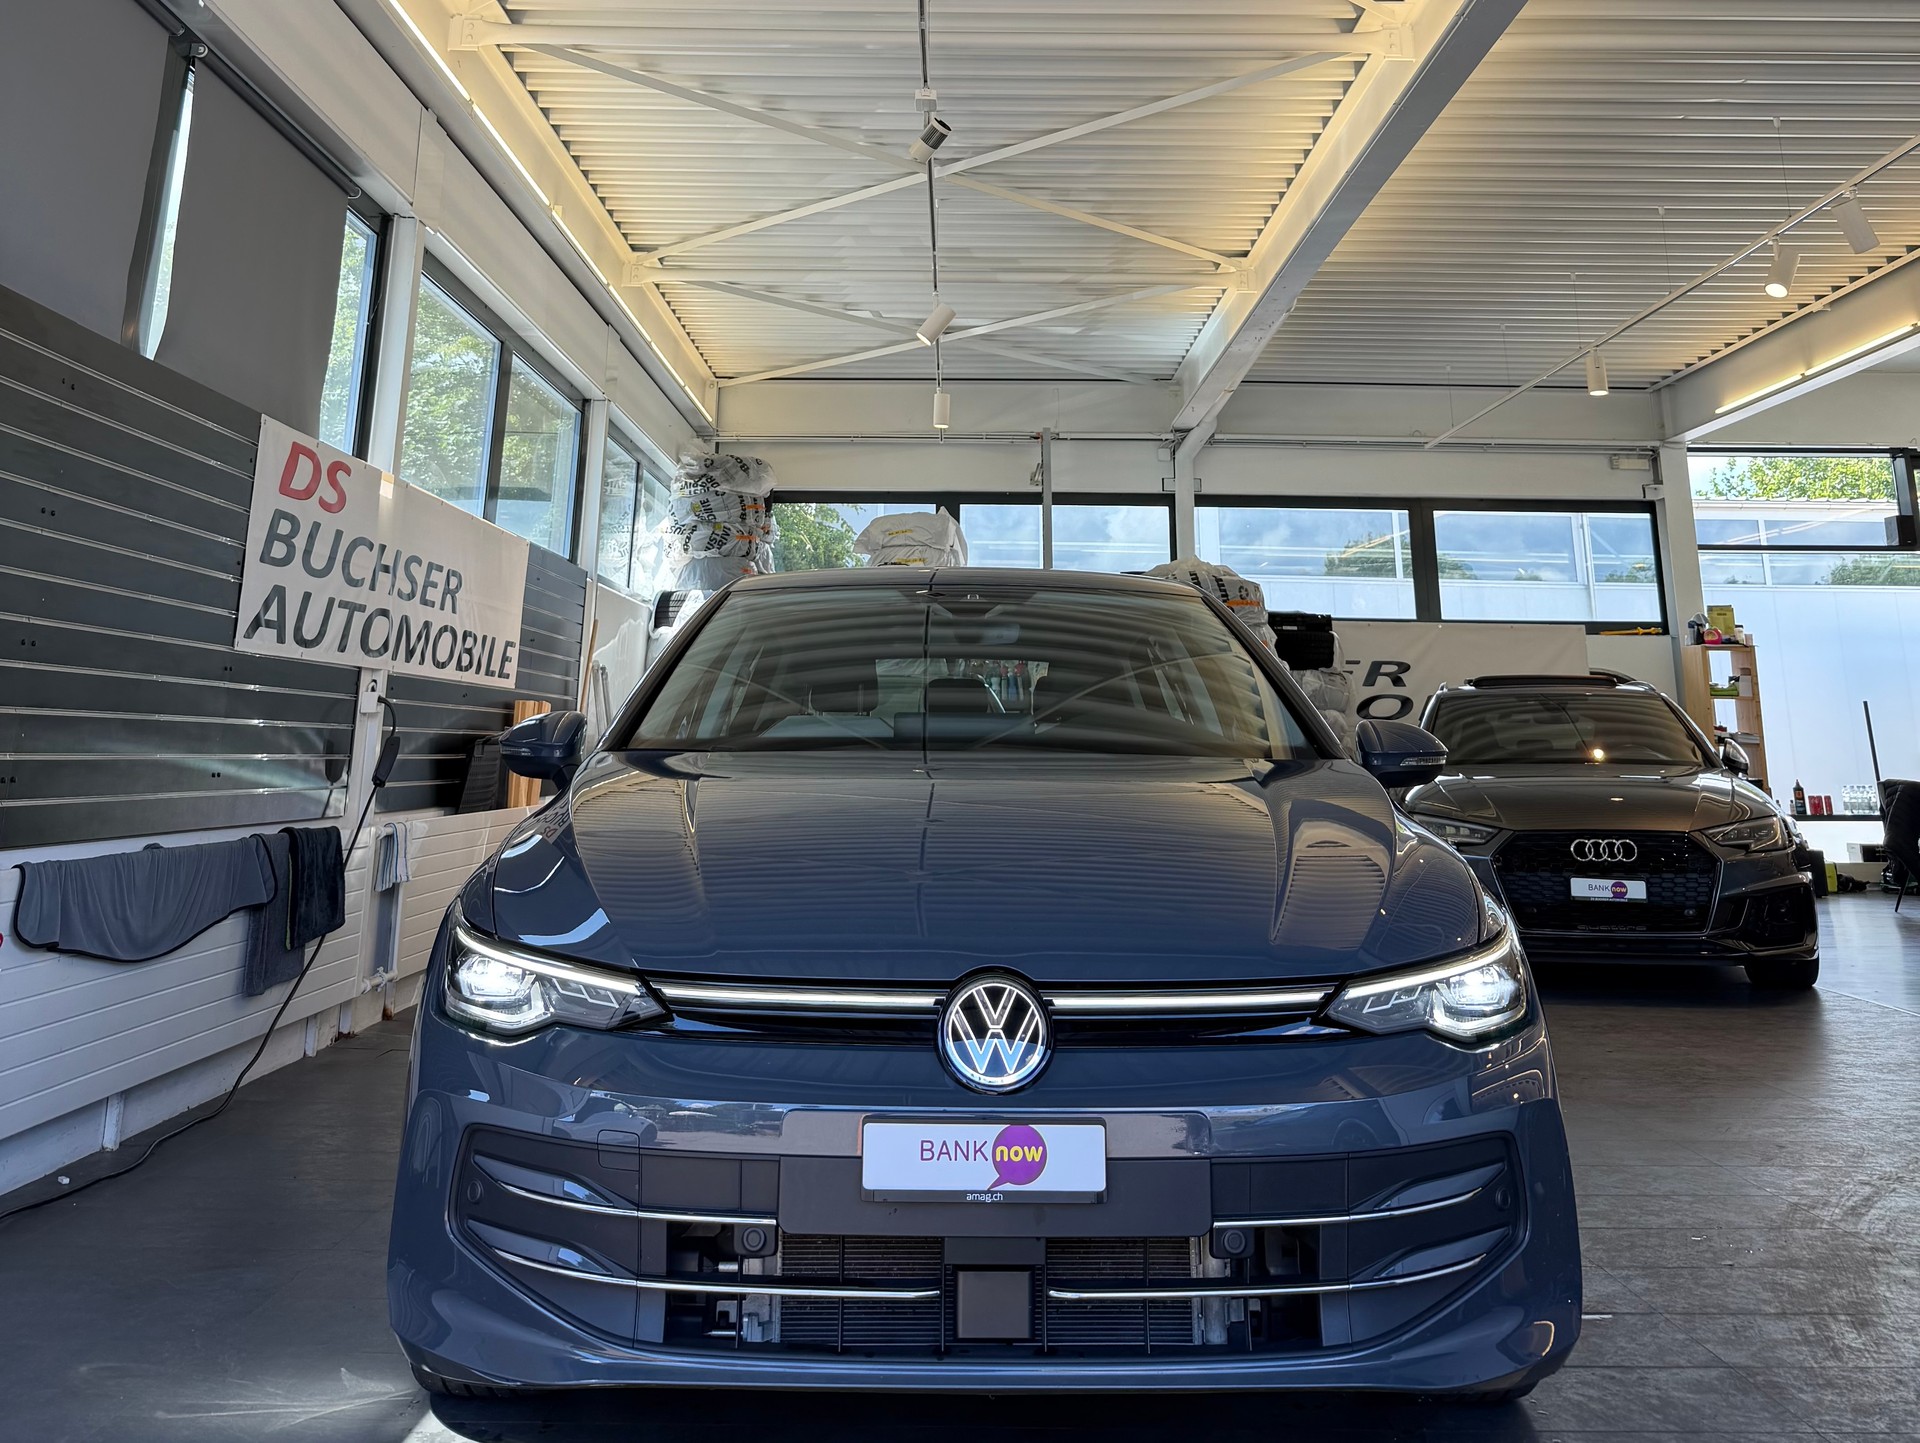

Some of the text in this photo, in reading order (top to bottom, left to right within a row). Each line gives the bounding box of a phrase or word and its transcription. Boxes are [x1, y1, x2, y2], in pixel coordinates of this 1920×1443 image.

[279, 441, 352, 514] DS
[259, 508, 463, 614] BUCHSER
[243, 584, 516, 679] AUTOMOBILE
[1588, 883, 1610, 892] BANK
[919, 1139, 1043, 1163] BANK now
[966, 1191, 1004, 1203] amag.ch
